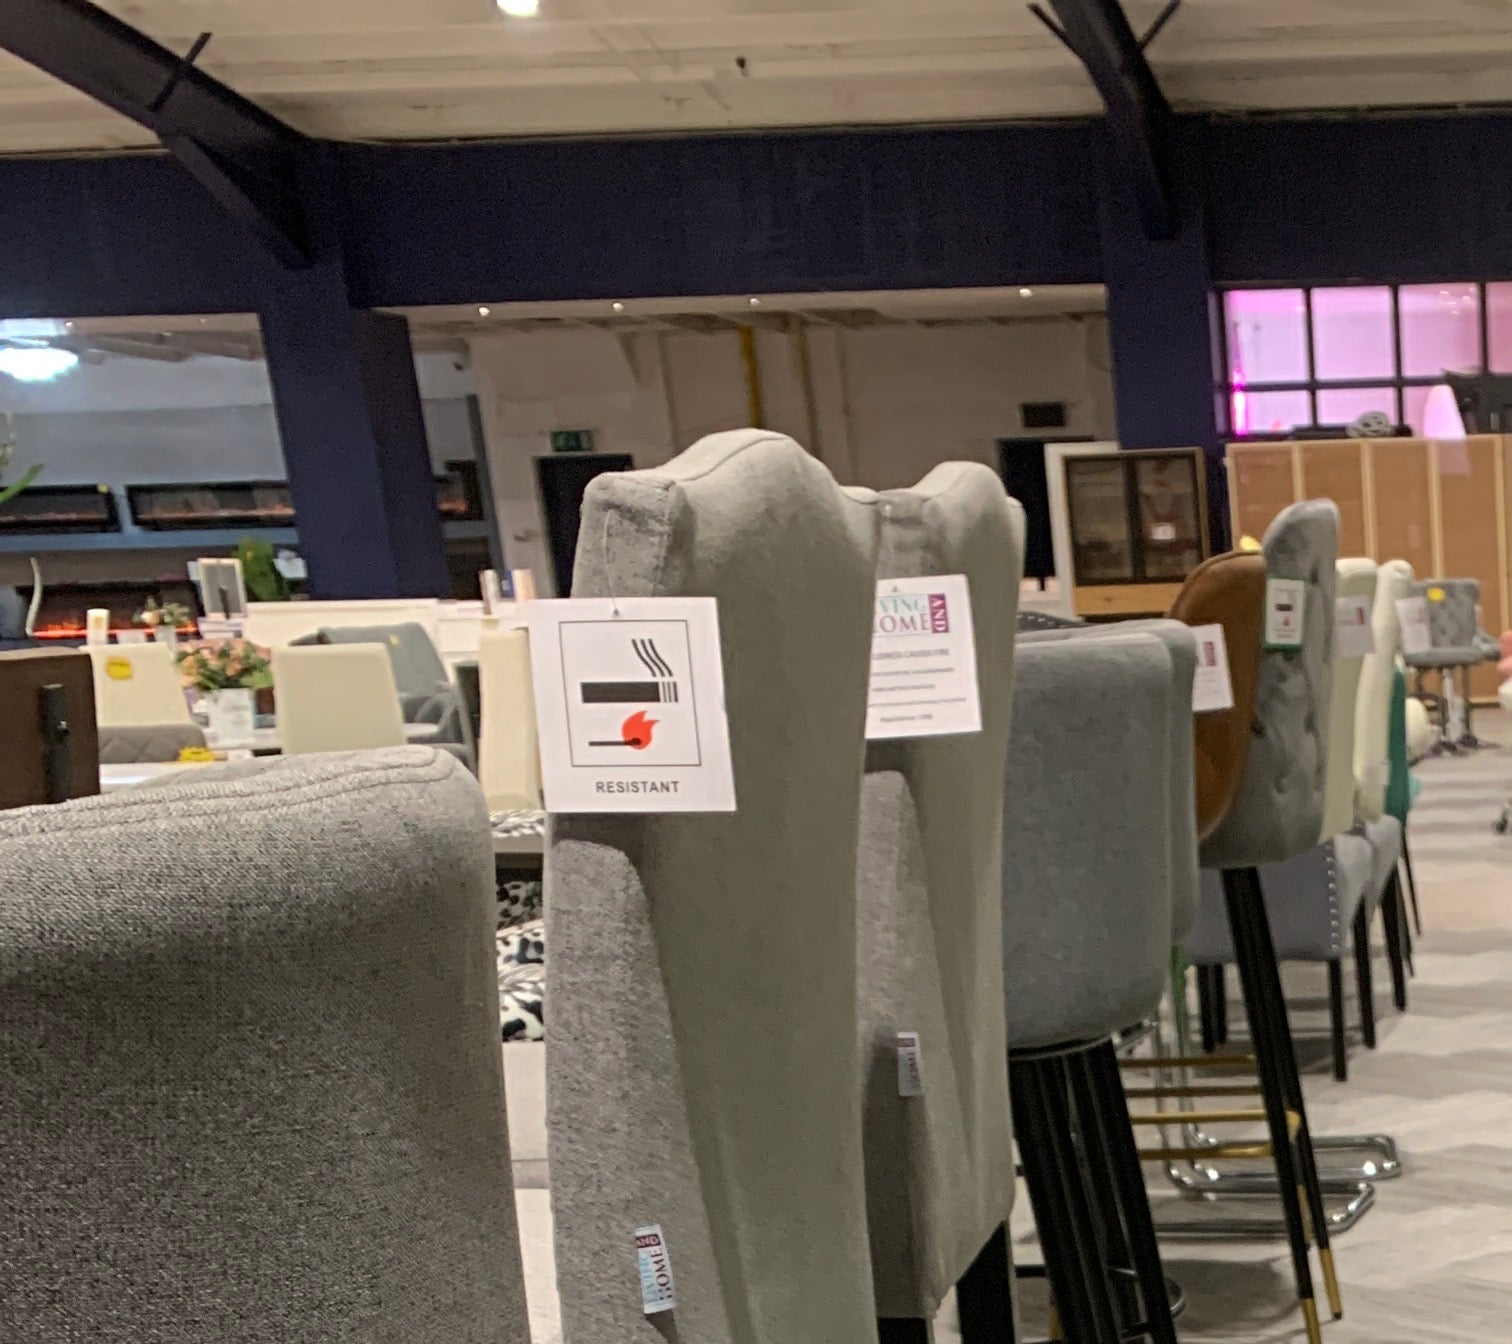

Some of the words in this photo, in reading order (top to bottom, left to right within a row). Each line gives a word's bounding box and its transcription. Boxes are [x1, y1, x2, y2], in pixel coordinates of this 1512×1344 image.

[879, 596, 926, 615] VING
[931, 597, 949, 632] AND
[879, 613, 931, 633] OME
[595, 780, 680, 794] RESISTANT
